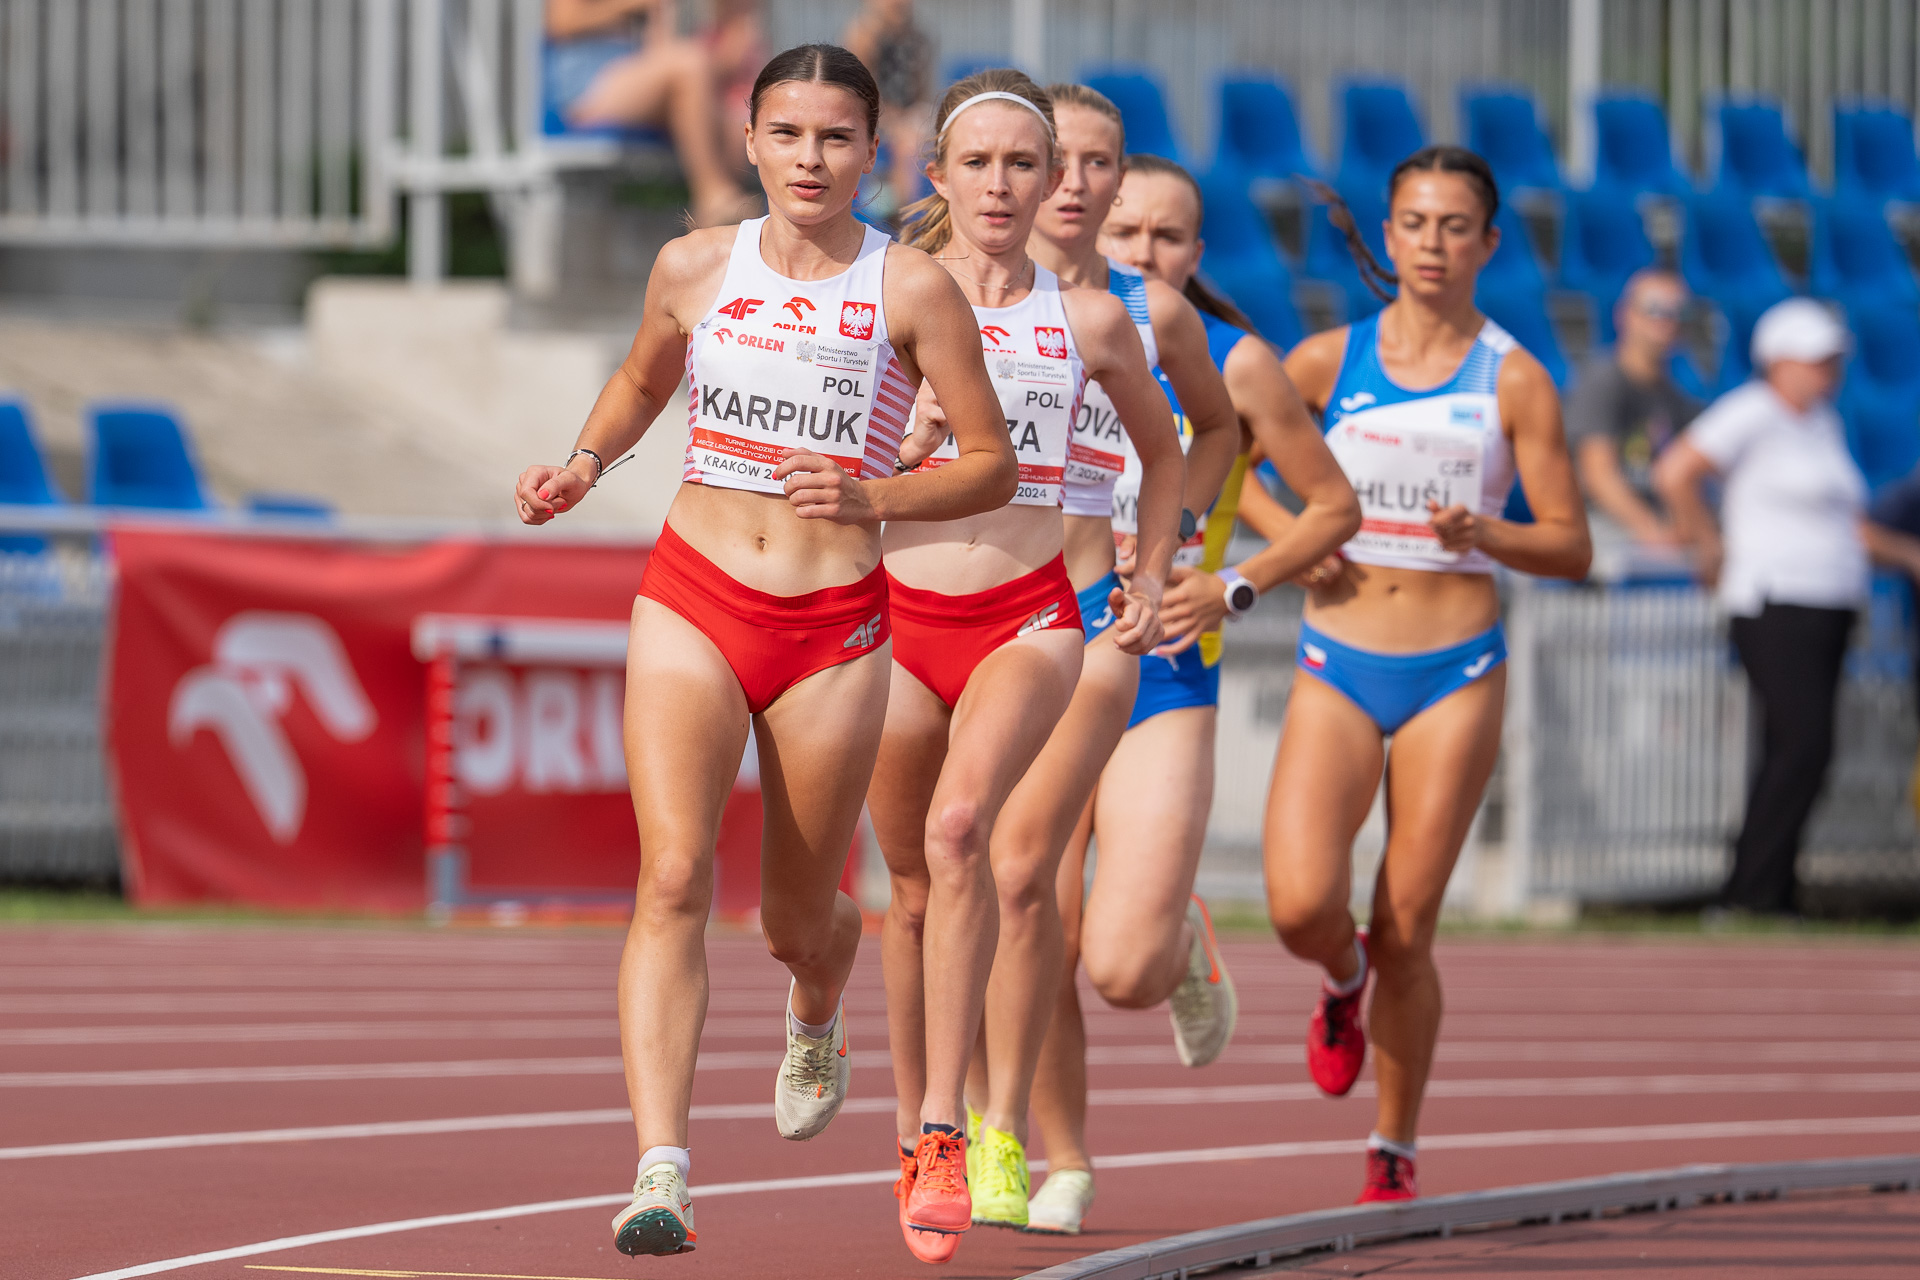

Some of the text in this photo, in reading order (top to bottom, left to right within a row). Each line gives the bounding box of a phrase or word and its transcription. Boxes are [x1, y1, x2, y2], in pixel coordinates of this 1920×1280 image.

[717, 298, 765, 320] 4F
[737, 333, 785, 352] ORLEN
[818, 345, 858, 357] Ministerstwo
[816, 353, 838, 362] Sportu
[843, 357, 869, 366] Turystyki
[1017, 362, 1055, 371] Ministerstwo
[1042, 371, 1067, 379] Turystyki
[822, 376, 865, 397] POL
[1025, 391, 1065, 409] POL
[702, 384, 863, 445] KARPIUK
[1075, 403, 1121, 444] OVA
[696, 438, 714, 448] MECZ
[714, 442, 772, 461] LEKKOATLETYCZNY
[724, 437, 750, 448] TURNIEJ
[749, 442, 776, 454] NADZIEI
[703, 454, 760, 477] KRAKÓW
[1439, 459, 1475, 478] CZE
[1017, 602, 1059, 637] 4F
[843, 613, 881, 648] 4F
